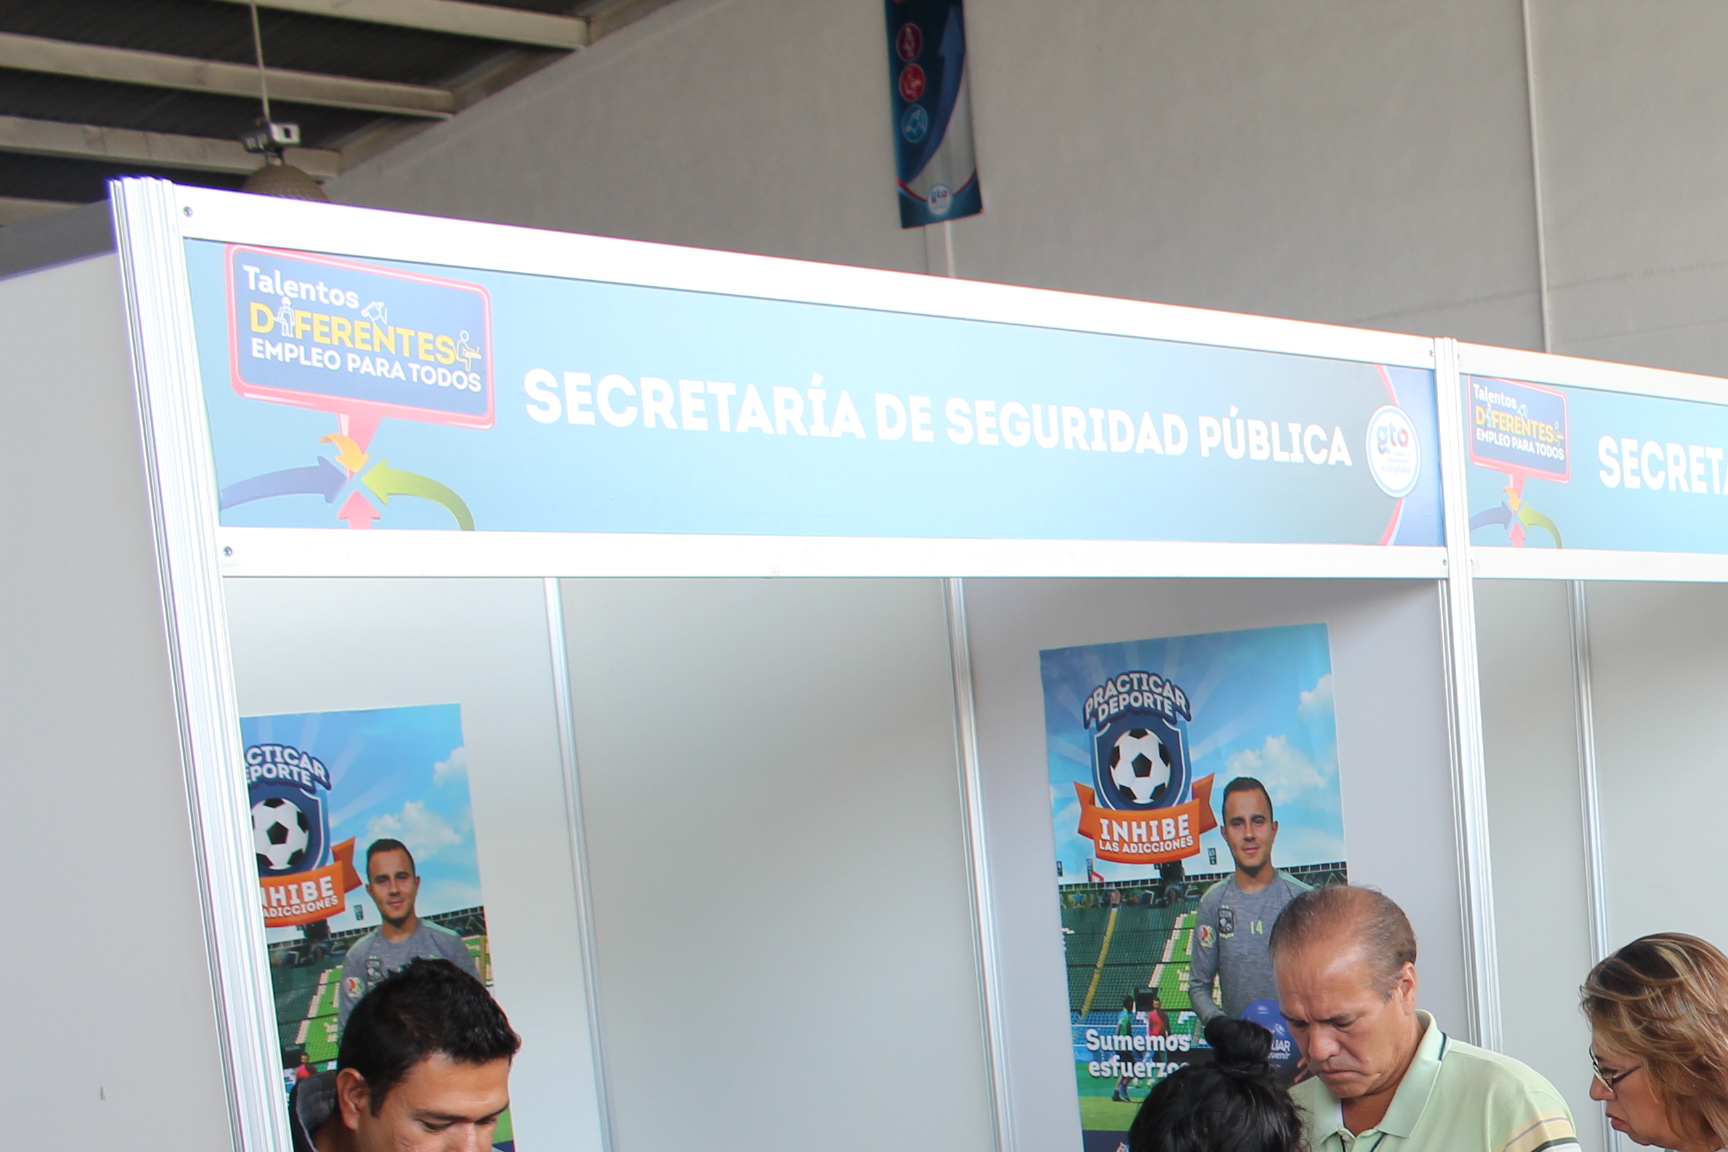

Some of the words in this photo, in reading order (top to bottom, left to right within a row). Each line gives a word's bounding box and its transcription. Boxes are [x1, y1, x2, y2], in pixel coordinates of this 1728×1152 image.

[243, 264, 360, 309] Talentos
[251, 337, 341, 370] EMPLEO
[347, 353, 406, 382] PARA
[408, 362, 482, 393] TODOS
[1472, 383, 1517, 410] Talentos
[523, 368, 867, 439] SECRETARÍA
[875, 392, 935, 443] DE
[945, 397, 1188, 456] SEGURIDAD
[1199, 404, 1353, 466] PÚBLICA
[1377, 421, 1409, 455] gto
[1476, 427, 1510, 448] EMPLEO
[1512, 436, 1535, 454] PARA
[1535, 441, 1564, 461] TODOS
[1085, 672, 1188, 722] PRACTICAR
[1098, 691, 1173, 723] DEPORTE
[244, 746, 327, 784] CTICAR
[1099, 814, 1190, 842] INHIBE
[1099, 839, 1120, 853] LAS
[1122, 836, 1193, 854] ADICCIONES
[1250, 920, 1263, 935] 14
[1085, 1028, 1191, 1051] Sumemos
